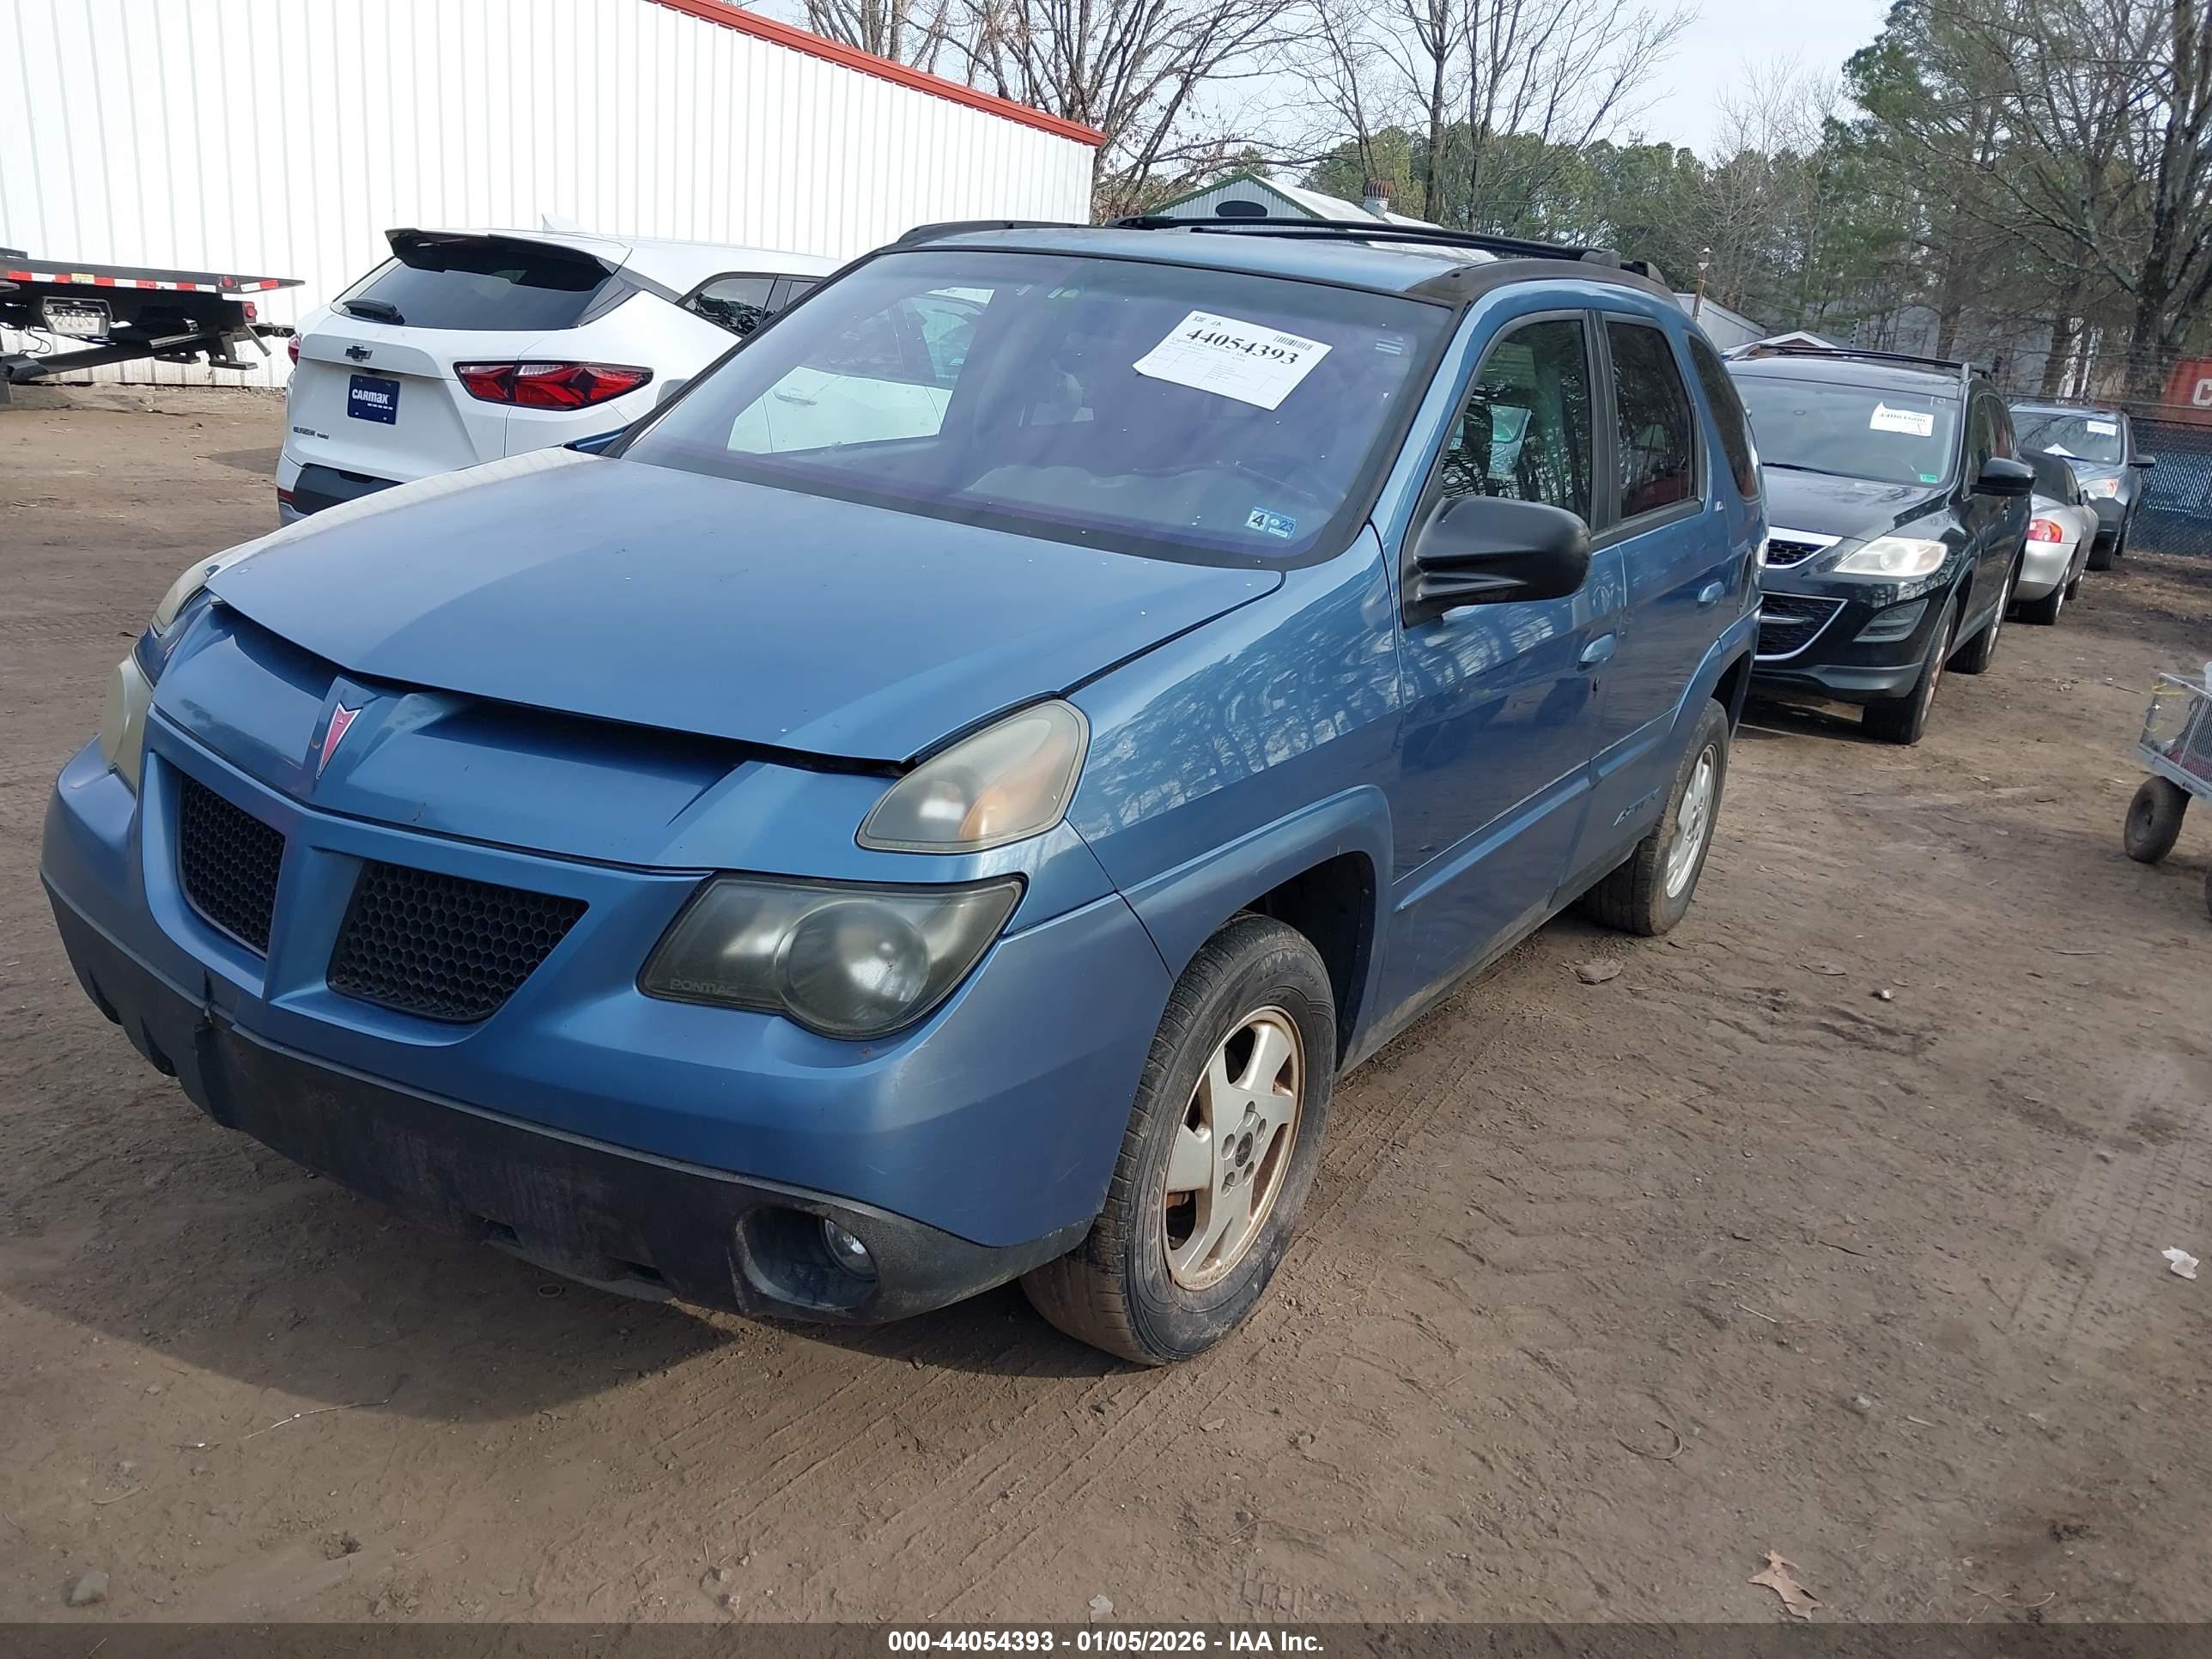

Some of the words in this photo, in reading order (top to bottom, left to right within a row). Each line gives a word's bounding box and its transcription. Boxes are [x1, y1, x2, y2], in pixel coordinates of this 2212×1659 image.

[1186, 329, 1299, 365] 44054393
[1252, 514, 1266, 527] 4
[1279, 520, 1295, 532] 23
